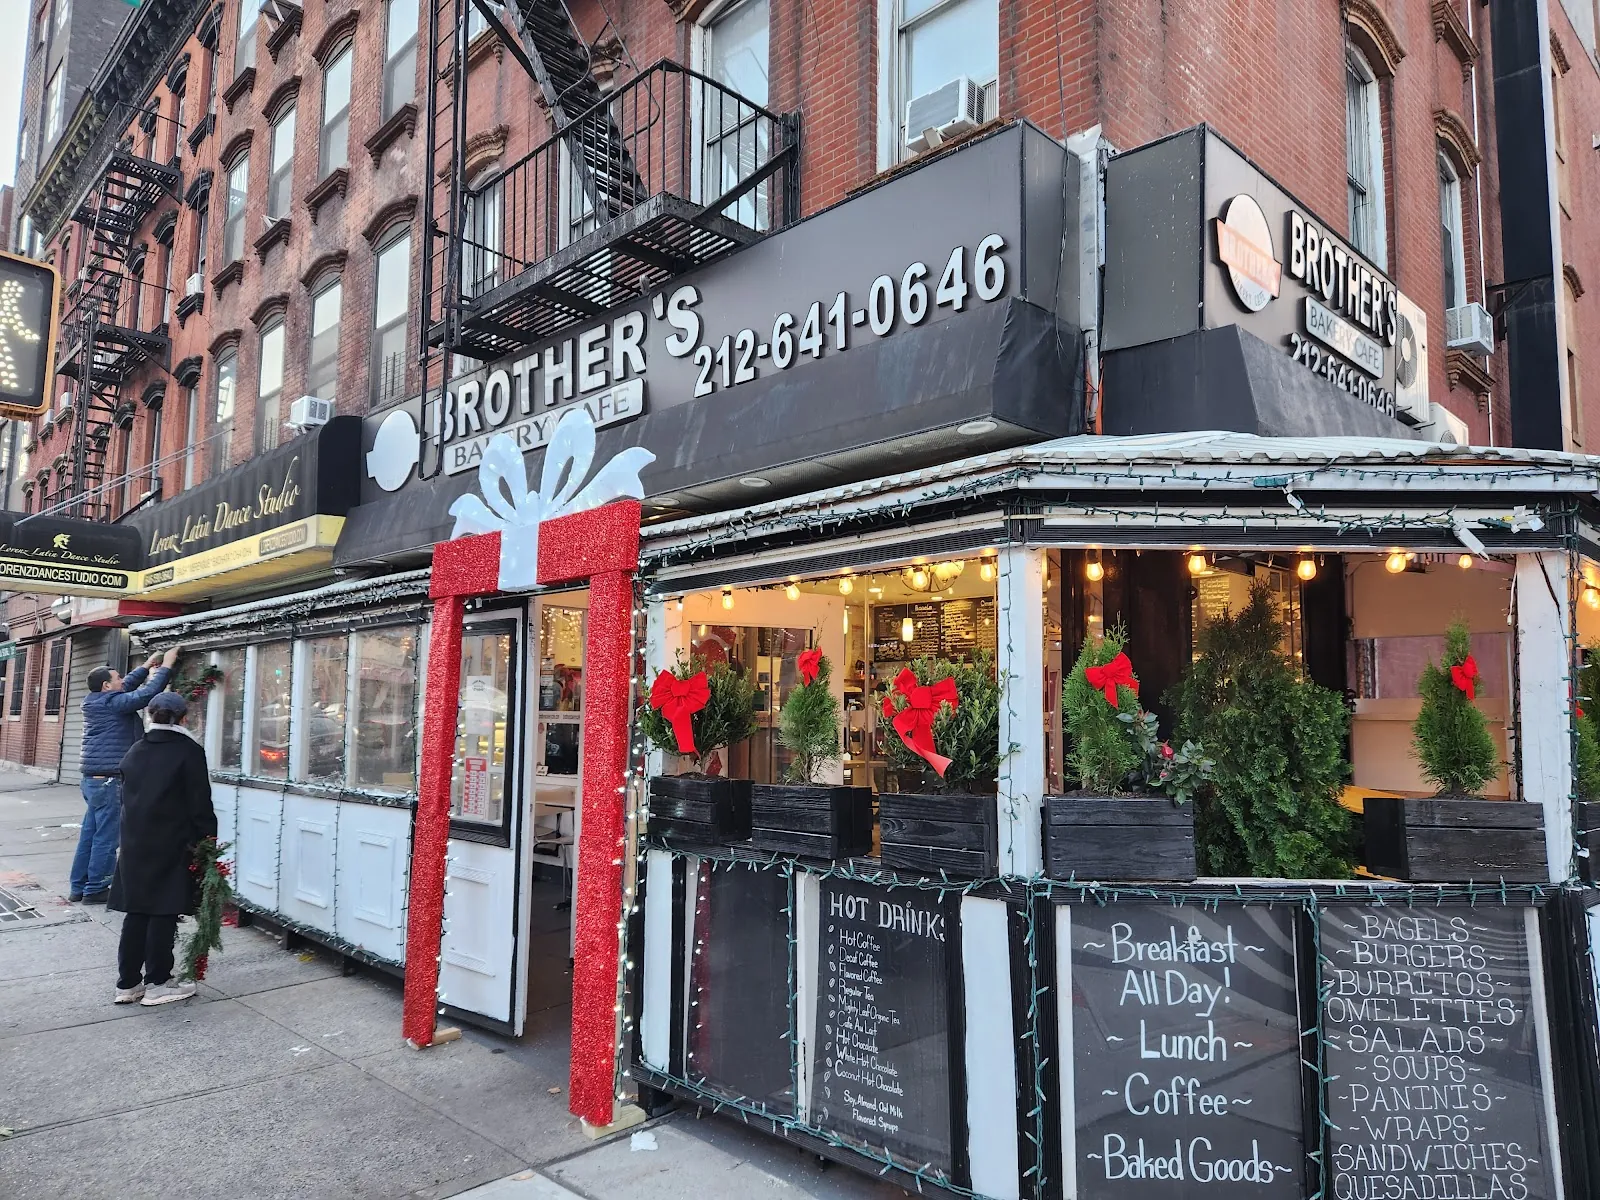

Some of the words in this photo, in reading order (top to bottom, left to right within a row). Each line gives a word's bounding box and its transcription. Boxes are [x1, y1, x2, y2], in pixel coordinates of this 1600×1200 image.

[1291, 209, 1396, 347] BROTHER'S
[693, 233, 1006, 398] 212-641-0646
[1310, 306, 1353, 352] BAKERY
[1355, 337, 1380, 370] CAFE
[434, 285, 700, 446] BROTHER'S
[454, 416, 549, 468] BARY
[148, 529, 182, 556] Lorenz
[180, 515, 211, 545] Latin
[214, 501, 252, 532] Dance
[253, 456, 301, 519] Studio
[0, 543, 33, 557] Lorenz
[29, 547, 58, 558] Latin
[61, 551, 89, 562] Dance
[91, 554, 120, 565] Studio
[830, 891, 869, 921] HOT
[840, 928, 857, 947] Hot
[856, 932, 880, 952] Coffee
[1111, 922, 1238, 963] Breakfast
[1361, 915, 1470, 942] BAGELS
[840, 946, 858, 963] Decaf
[859, 952, 878, 968] Coffee
[1351, 941, 1486, 969] BURGERS
[839, 962, 862, 980] Flavored
[863, 969, 883, 984] Coffee
[1334, 970, 1494, 998] BURRITOS
[839, 978, 863, 997] Regular
[864, 986, 874, 1001] Tea
[1119, 969, 1160, 1006] All
[1165, 967, 1231, 1017] Day!
[838, 994, 858, 1017] Mighty
[859, 1001, 870, 1017] Leaf
[888, 1010, 900, 1026] Tea
[838, 1011, 853, 1029] Cafe
[854, 1018, 863, 1032] Au
[865, 1020, 877, 1036] Lait
[1327, 998, 1516, 1026] OMELETTES
[836, 1028, 850, 1045] Hot
[852, 1033, 879, 1053] Chocolate
[1140, 1019, 1227, 1062] Lunch
[1347, 1025, 1485, 1054] SALADS
[836, 1044, 855, 1063] White
[856, 1051, 870, 1068] Hot
[871, 1056, 898, 1077] Chocolate
[1372, 1055, 1466, 1082] SOUPS
[835, 1059, 860, 1082] Coconut
[861, 1070, 875, 1087] Hot
[876, 1074, 904, 1096] Chocolate
[1124, 1072, 1228, 1116] Coffee
[1348, 1083, 1491, 1112] PANINIS
[853, 1108, 877, 1126] Flavored
[878, 1116, 899, 1134] Syrups
[879, 1101, 889, 1114] Oat
[889, 1104, 903, 1119] Milk
[1361, 1115, 1470, 1141] WRAPS
[1103, 1133, 1184, 1180] Baked
[1188, 1136, 1274, 1183] Goods
[1335, 1143, 1526, 1172] SANDWICHES
[1334, 1173, 1528, 1200] QUESADILLAS
